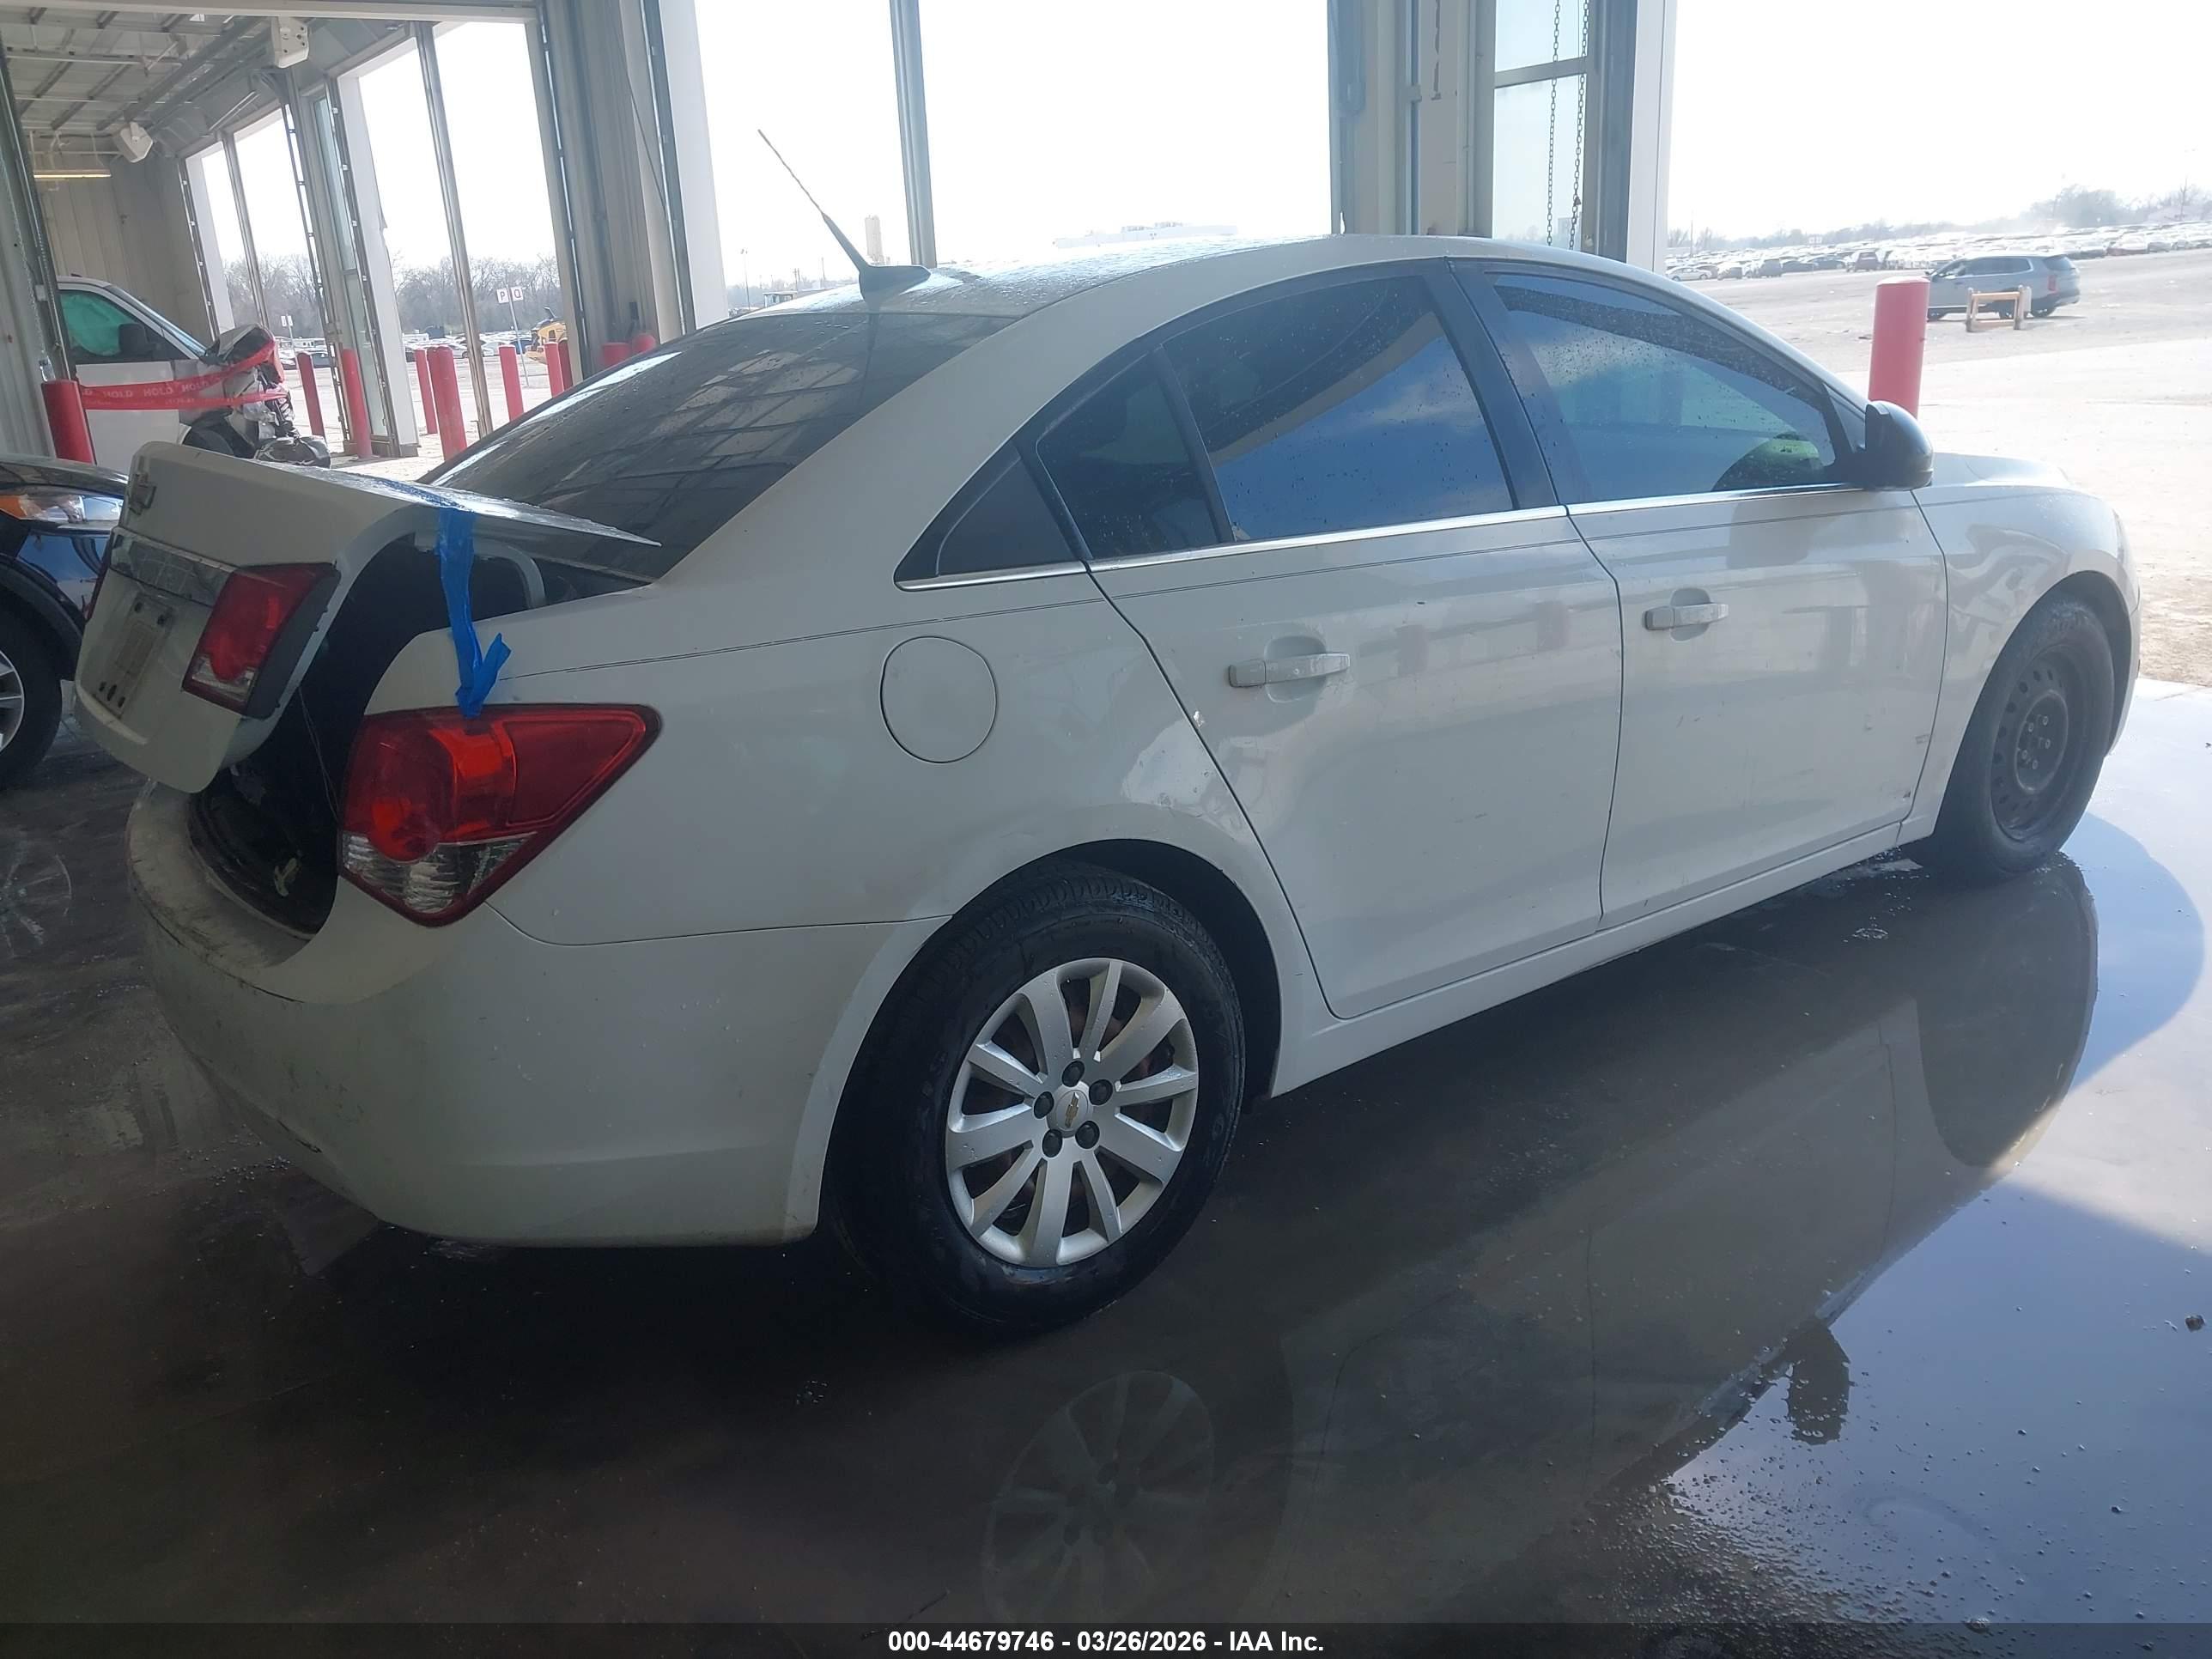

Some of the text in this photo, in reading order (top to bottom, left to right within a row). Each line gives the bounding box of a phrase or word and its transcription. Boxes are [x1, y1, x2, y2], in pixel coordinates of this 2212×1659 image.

[102, 389, 133, 398] HOLD
[143, 386, 173, 397] HOLD
[181, 380, 209, 392] HOLD
